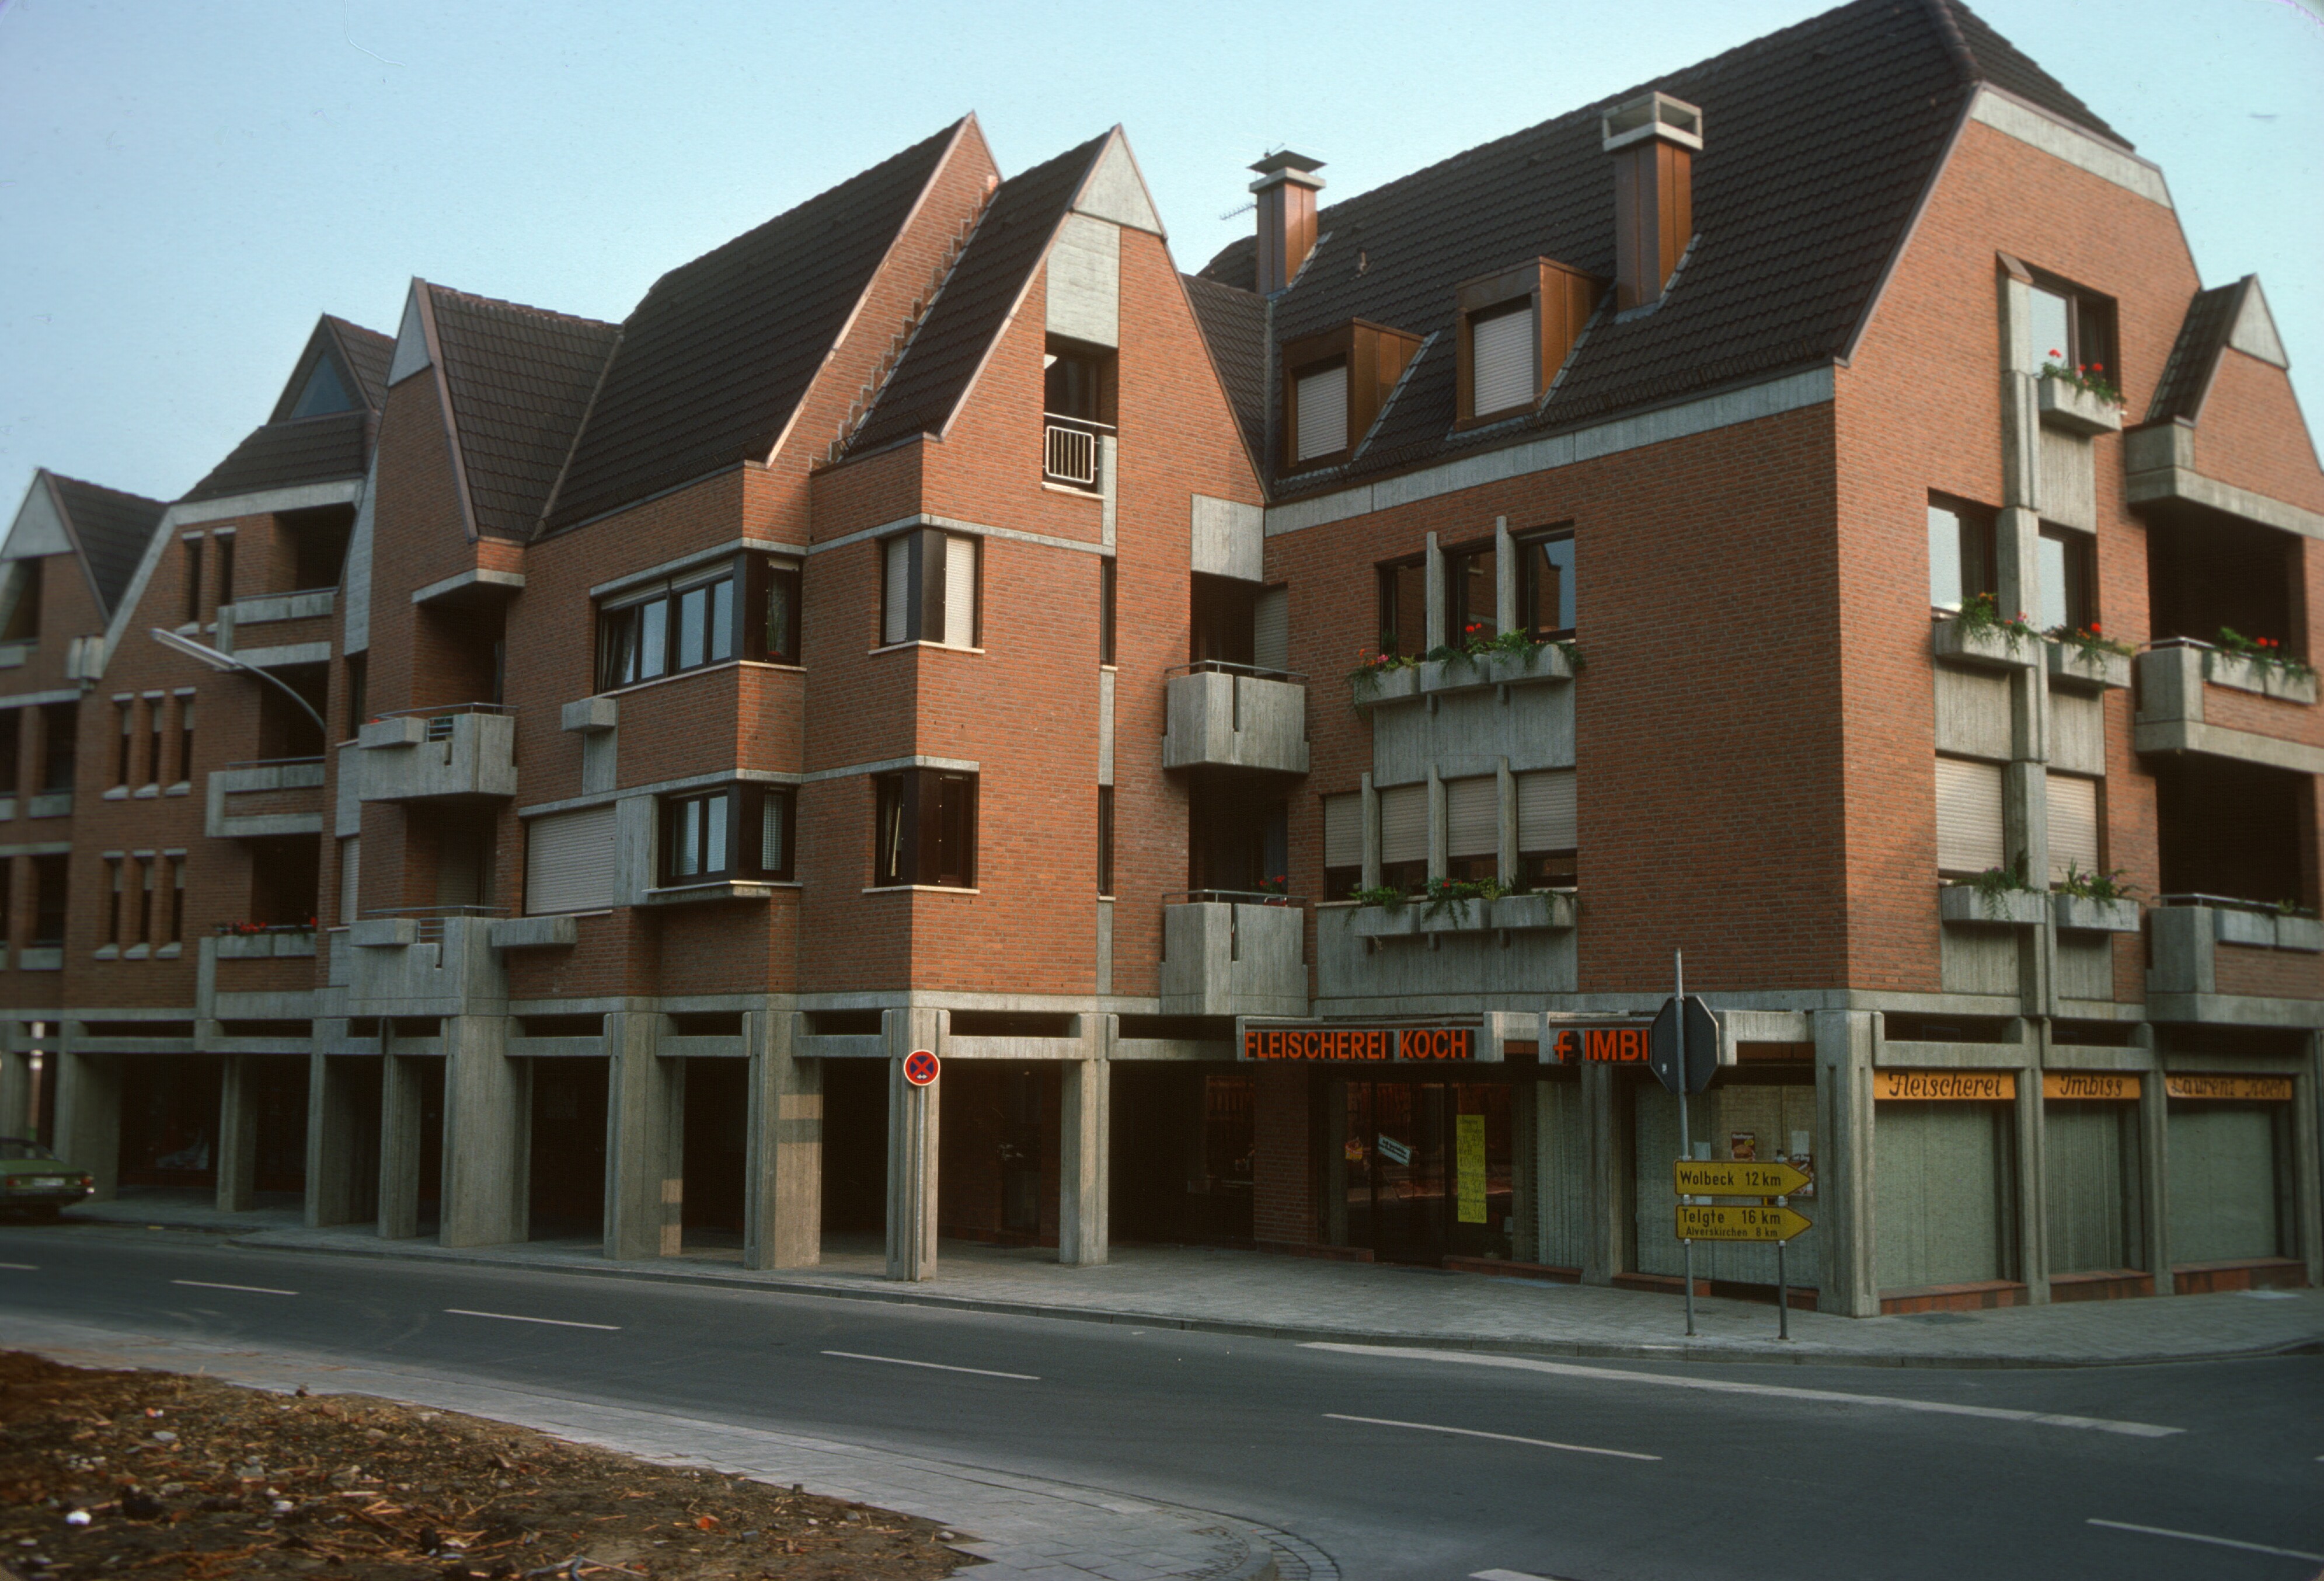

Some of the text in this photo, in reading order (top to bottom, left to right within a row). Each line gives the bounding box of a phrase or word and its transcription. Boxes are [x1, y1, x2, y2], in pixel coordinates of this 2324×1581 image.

[1245, 1029, 1467, 1059] FLEISCHEREI KOCH
[1584, 1029, 1648, 1060] IMBI
[1889, 1071, 2002, 1097] Fleischerei
[2060, 1074, 2123, 1097] Imbiss
[1680, 1170, 1781, 1186] Wolbeck 12 km
[1682, 1209, 1780, 1227] Telgte 16 km
[1686, 1227, 1778, 1237] Alverskirchen 8 km
